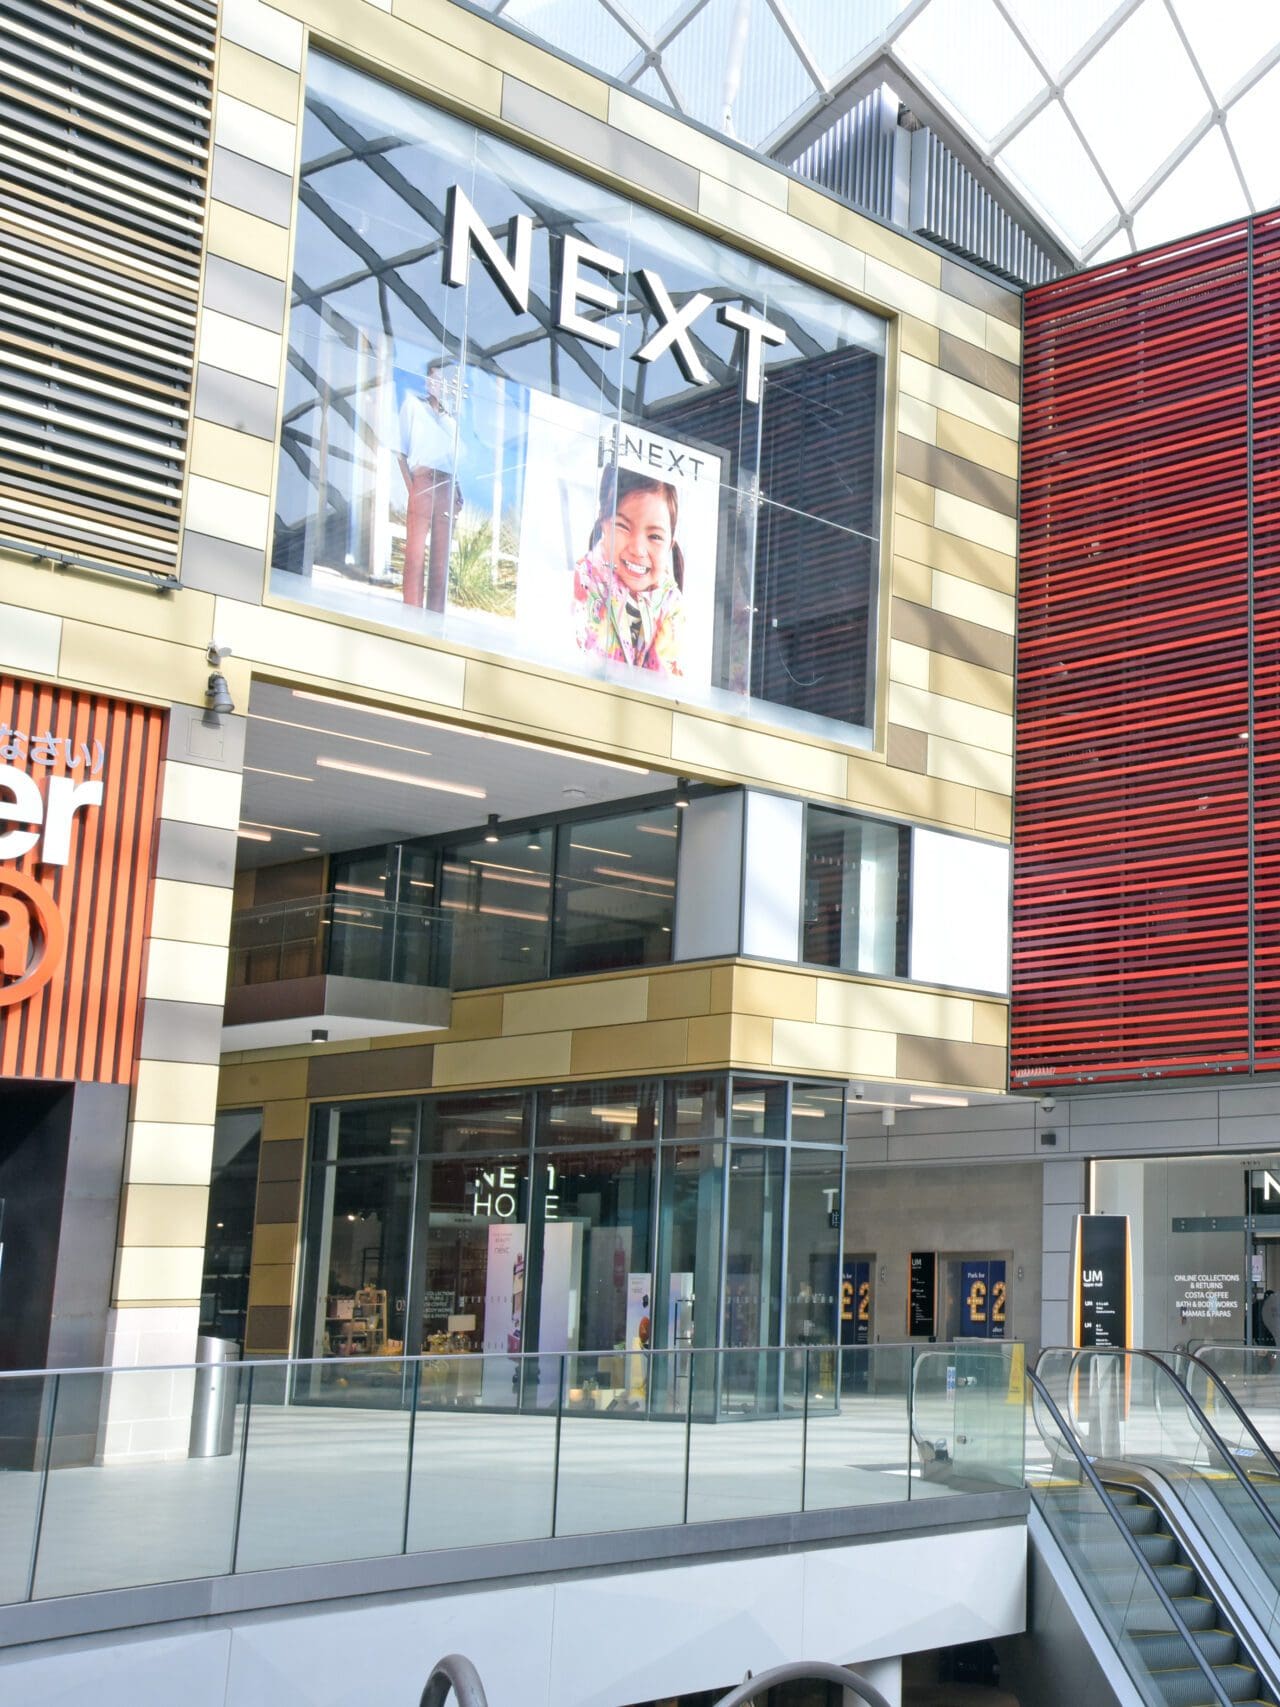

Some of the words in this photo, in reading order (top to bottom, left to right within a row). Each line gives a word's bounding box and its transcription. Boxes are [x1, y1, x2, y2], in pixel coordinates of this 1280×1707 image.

[441, 184, 786, 404] NEXT
[624, 433, 705, 478] NEXT
[473, 1193, 559, 1218] HOE
[1083, 1270, 1103, 1282] UM
[966, 1280, 1007, 1322] £2
[1184, 1291, 1205, 1299] COSTA
[1205, 1291, 1230, 1299] COFFEE
[1182, 1310, 1206, 1318] MAMAS
[1206, 1310, 1211, 1318] &
[1211, 1310, 1232, 1318] PAPAS
